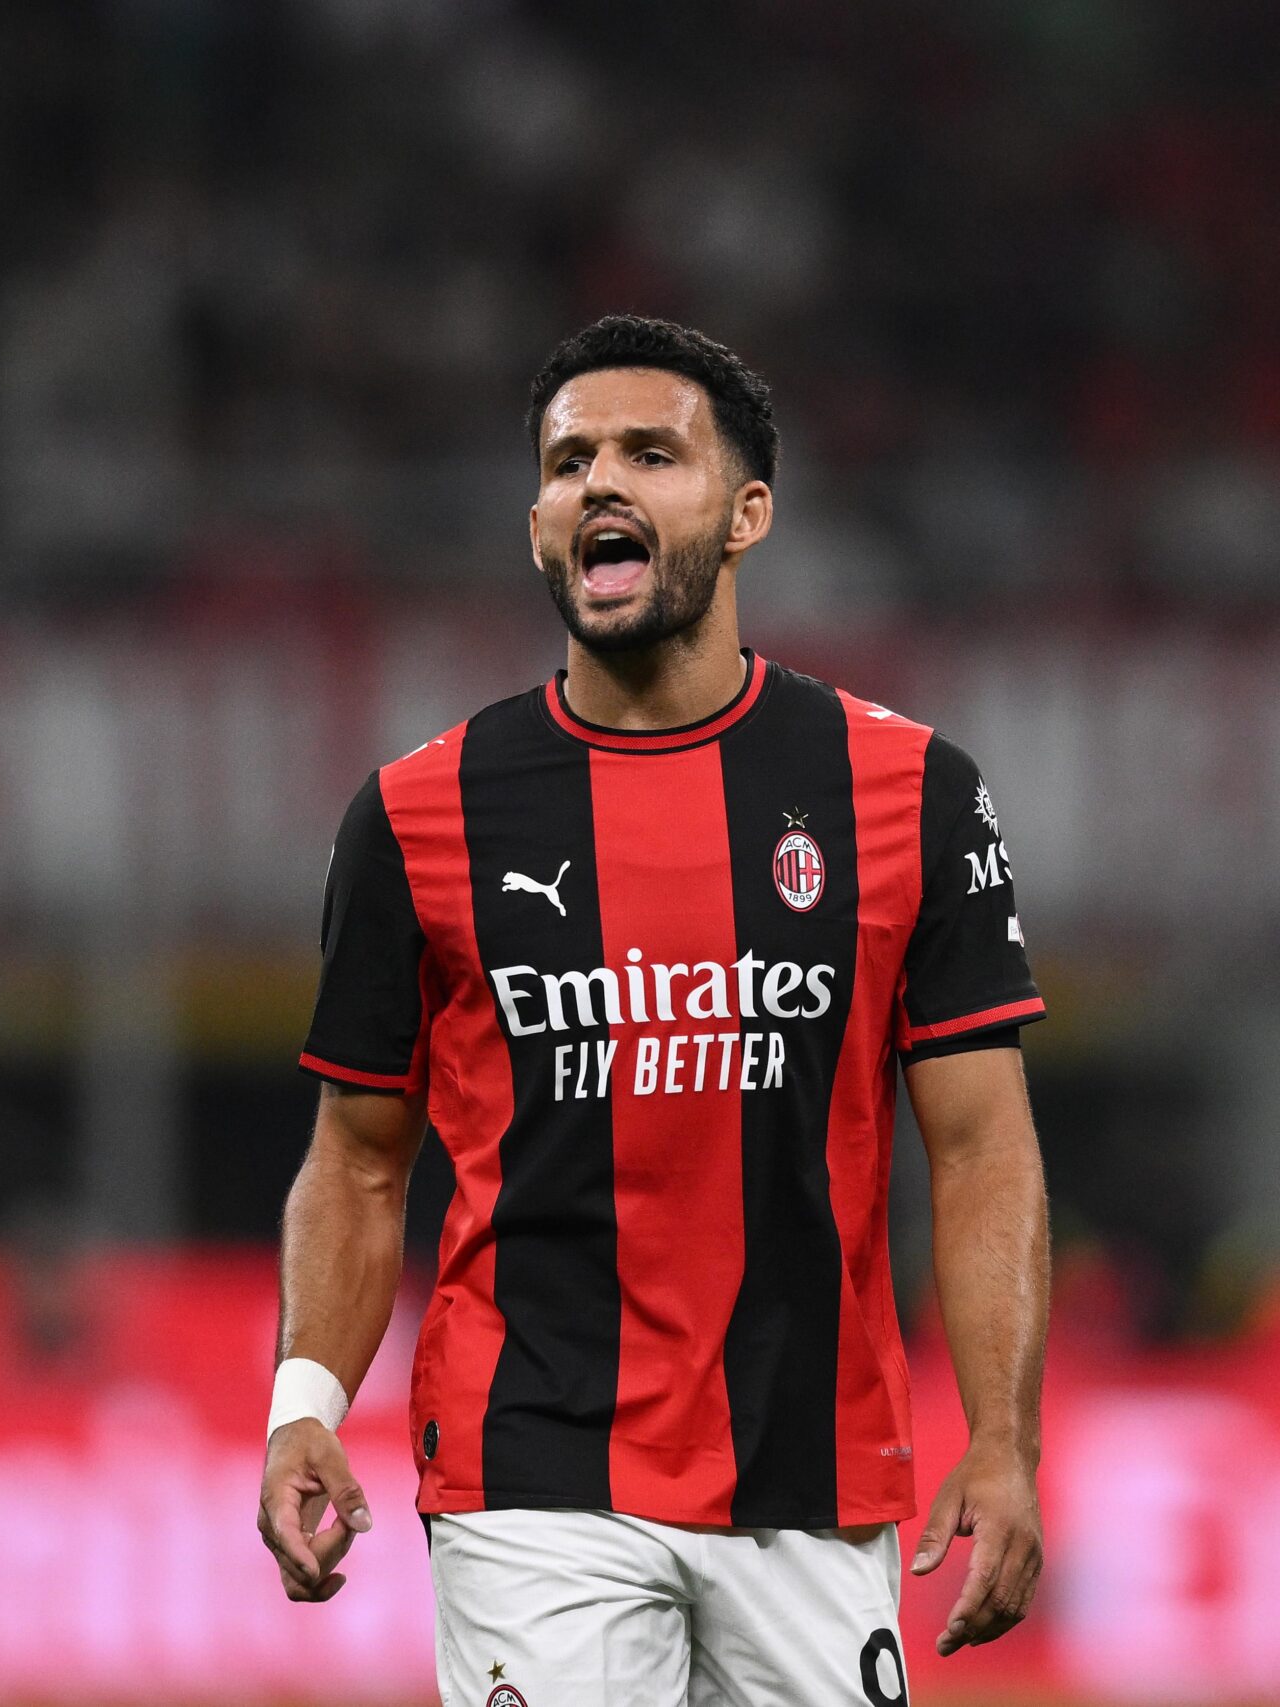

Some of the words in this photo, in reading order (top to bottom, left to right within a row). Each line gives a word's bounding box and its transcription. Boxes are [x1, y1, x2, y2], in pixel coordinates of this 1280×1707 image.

[783, 837, 813, 853] ACM
[787, 892, 813, 903] 1899
[489, 947, 836, 1037] Emirates
[554, 1039, 619, 1101] FLY
[633, 1032, 786, 1096] BETTER
[493, 1692, 517, 1707] ACM
